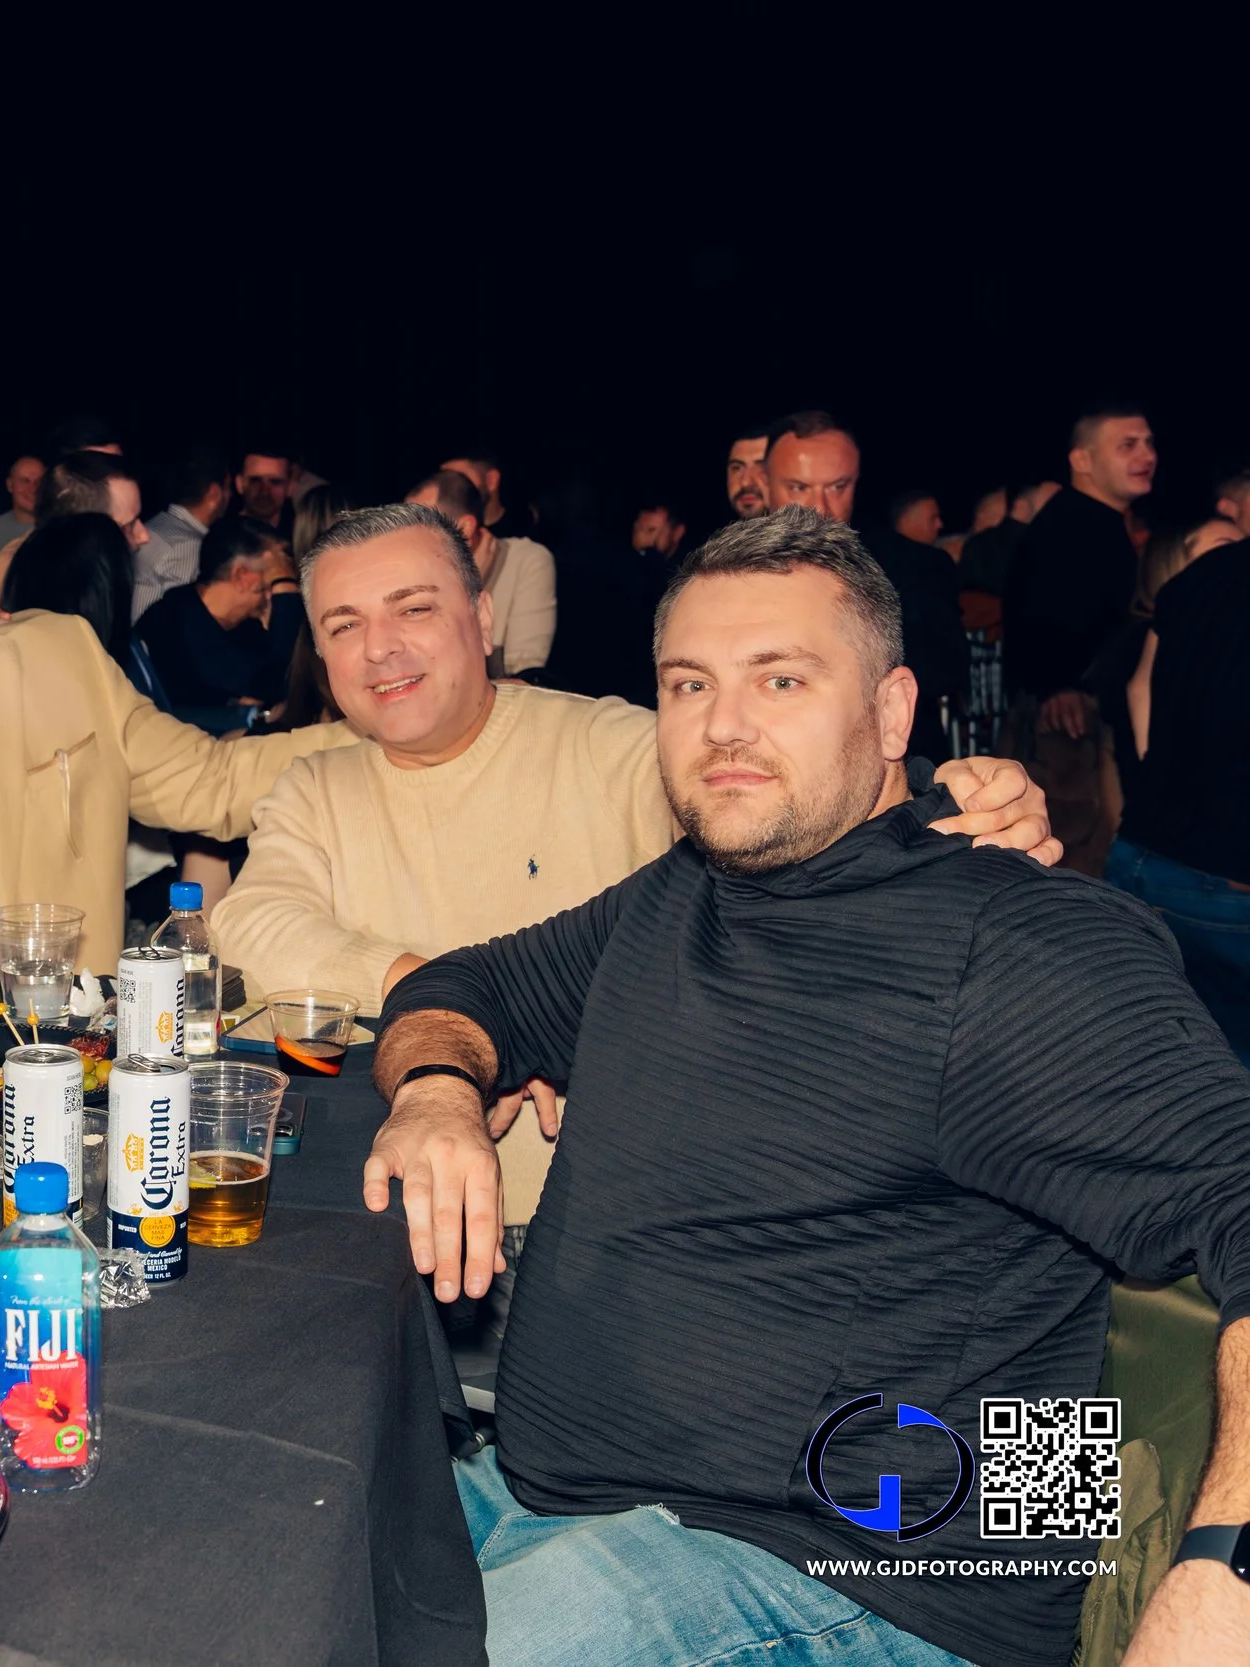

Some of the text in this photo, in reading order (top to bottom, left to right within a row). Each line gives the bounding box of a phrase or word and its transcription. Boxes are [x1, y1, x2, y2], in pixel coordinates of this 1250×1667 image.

[140, 1096, 176, 1210] Corona
[171, 1121, 186, 1180] Extra
[5, 1308, 77, 1362] FIJI
